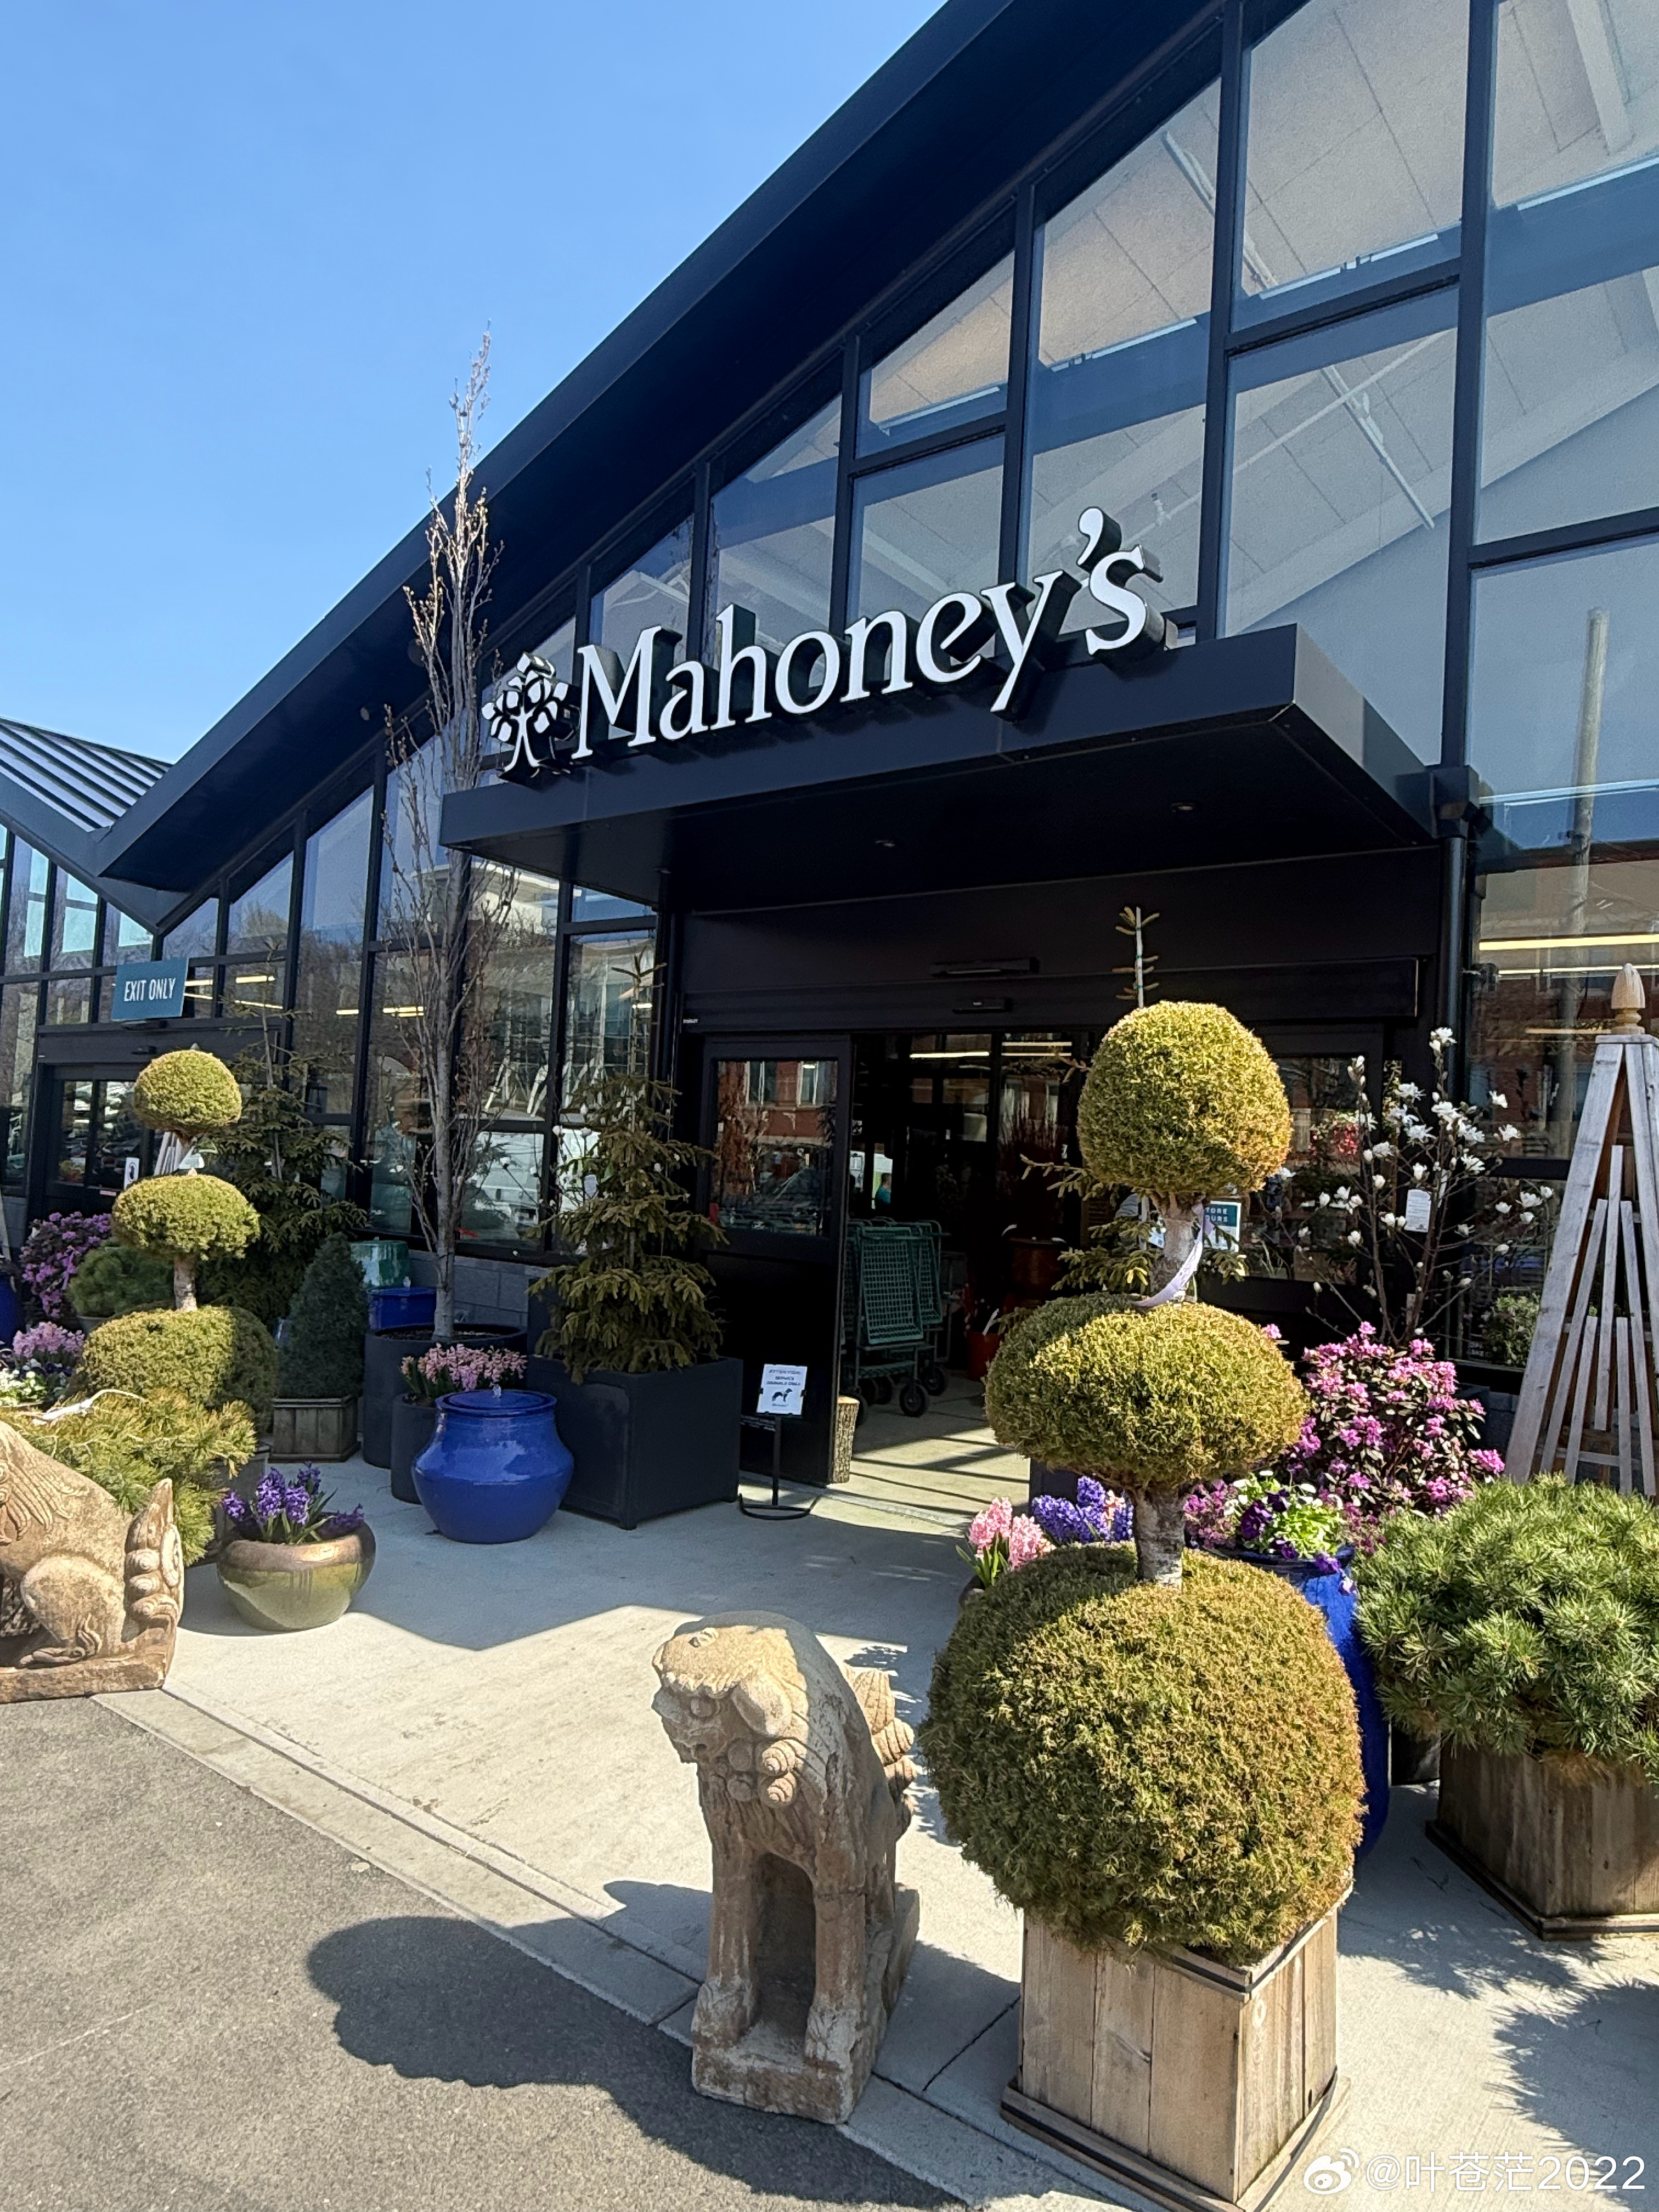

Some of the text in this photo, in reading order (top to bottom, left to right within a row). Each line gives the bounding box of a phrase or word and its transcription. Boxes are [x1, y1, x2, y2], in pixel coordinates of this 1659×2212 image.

[571, 507, 1147, 760] Mahoney's
[123, 978, 176, 1002] EXIT ONLY
